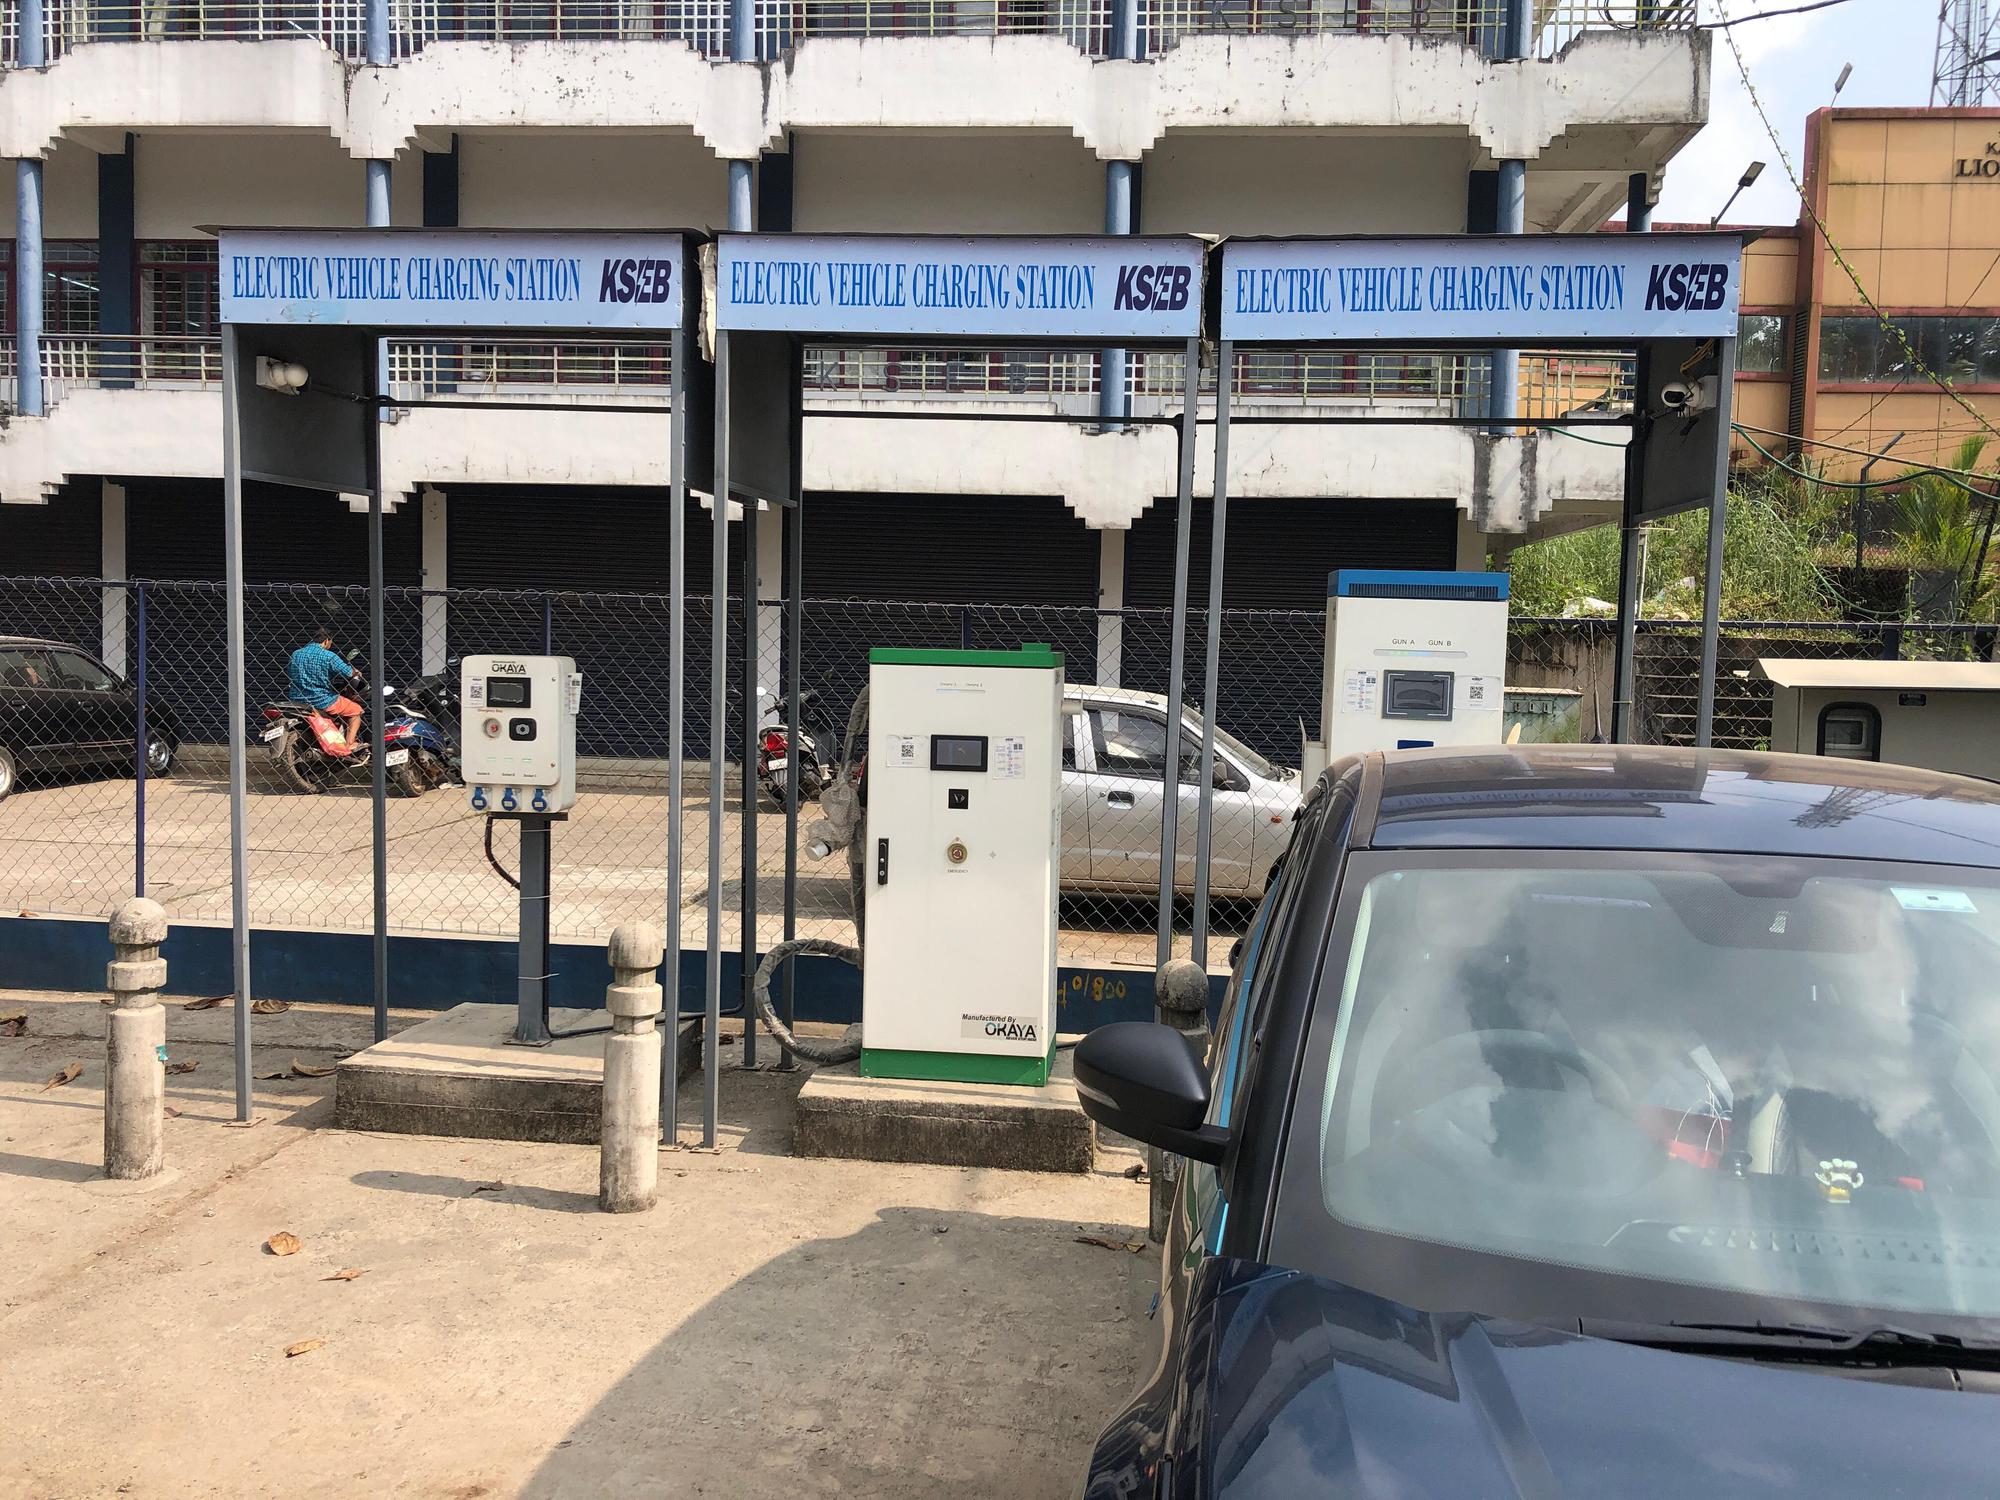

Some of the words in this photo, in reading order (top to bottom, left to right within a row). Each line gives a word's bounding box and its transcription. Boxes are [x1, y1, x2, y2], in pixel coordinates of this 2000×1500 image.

[1986, 141, 2000, 155] K
[232, 256, 319, 298] ELECTRIC
[324, 257, 401, 300] VEHICLE
[407, 258, 500, 301] CHARGING
[505, 258, 581, 301] STATION
[599, 257, 671, 304] KSEB
[731, 261, 821, 306] ELECTRIC
[827, 262, 907, 308] VEHICLE
[913, 263, 1010, 309] CHARGING
[1016, 264, 1096, 310] STATION
[1113, 263, 1192, 312] KSEB
[1235, 268, 1332, 313] ELECTRIC
[1338, 267, 1423, 312] VEHICLE
[1429, 265, 1534, 312] CHARGING
[1539, 264, 1626, 311] STATION
[1644, 262, 1729, 312] KSEB
[491, 663, 526, 673] OKAYA
[961, 1013, 1007, 1023] Manufactured
[1007, 1015, 1017, 1024] By
[984, 1021, 1037, 1038] OKAYA
